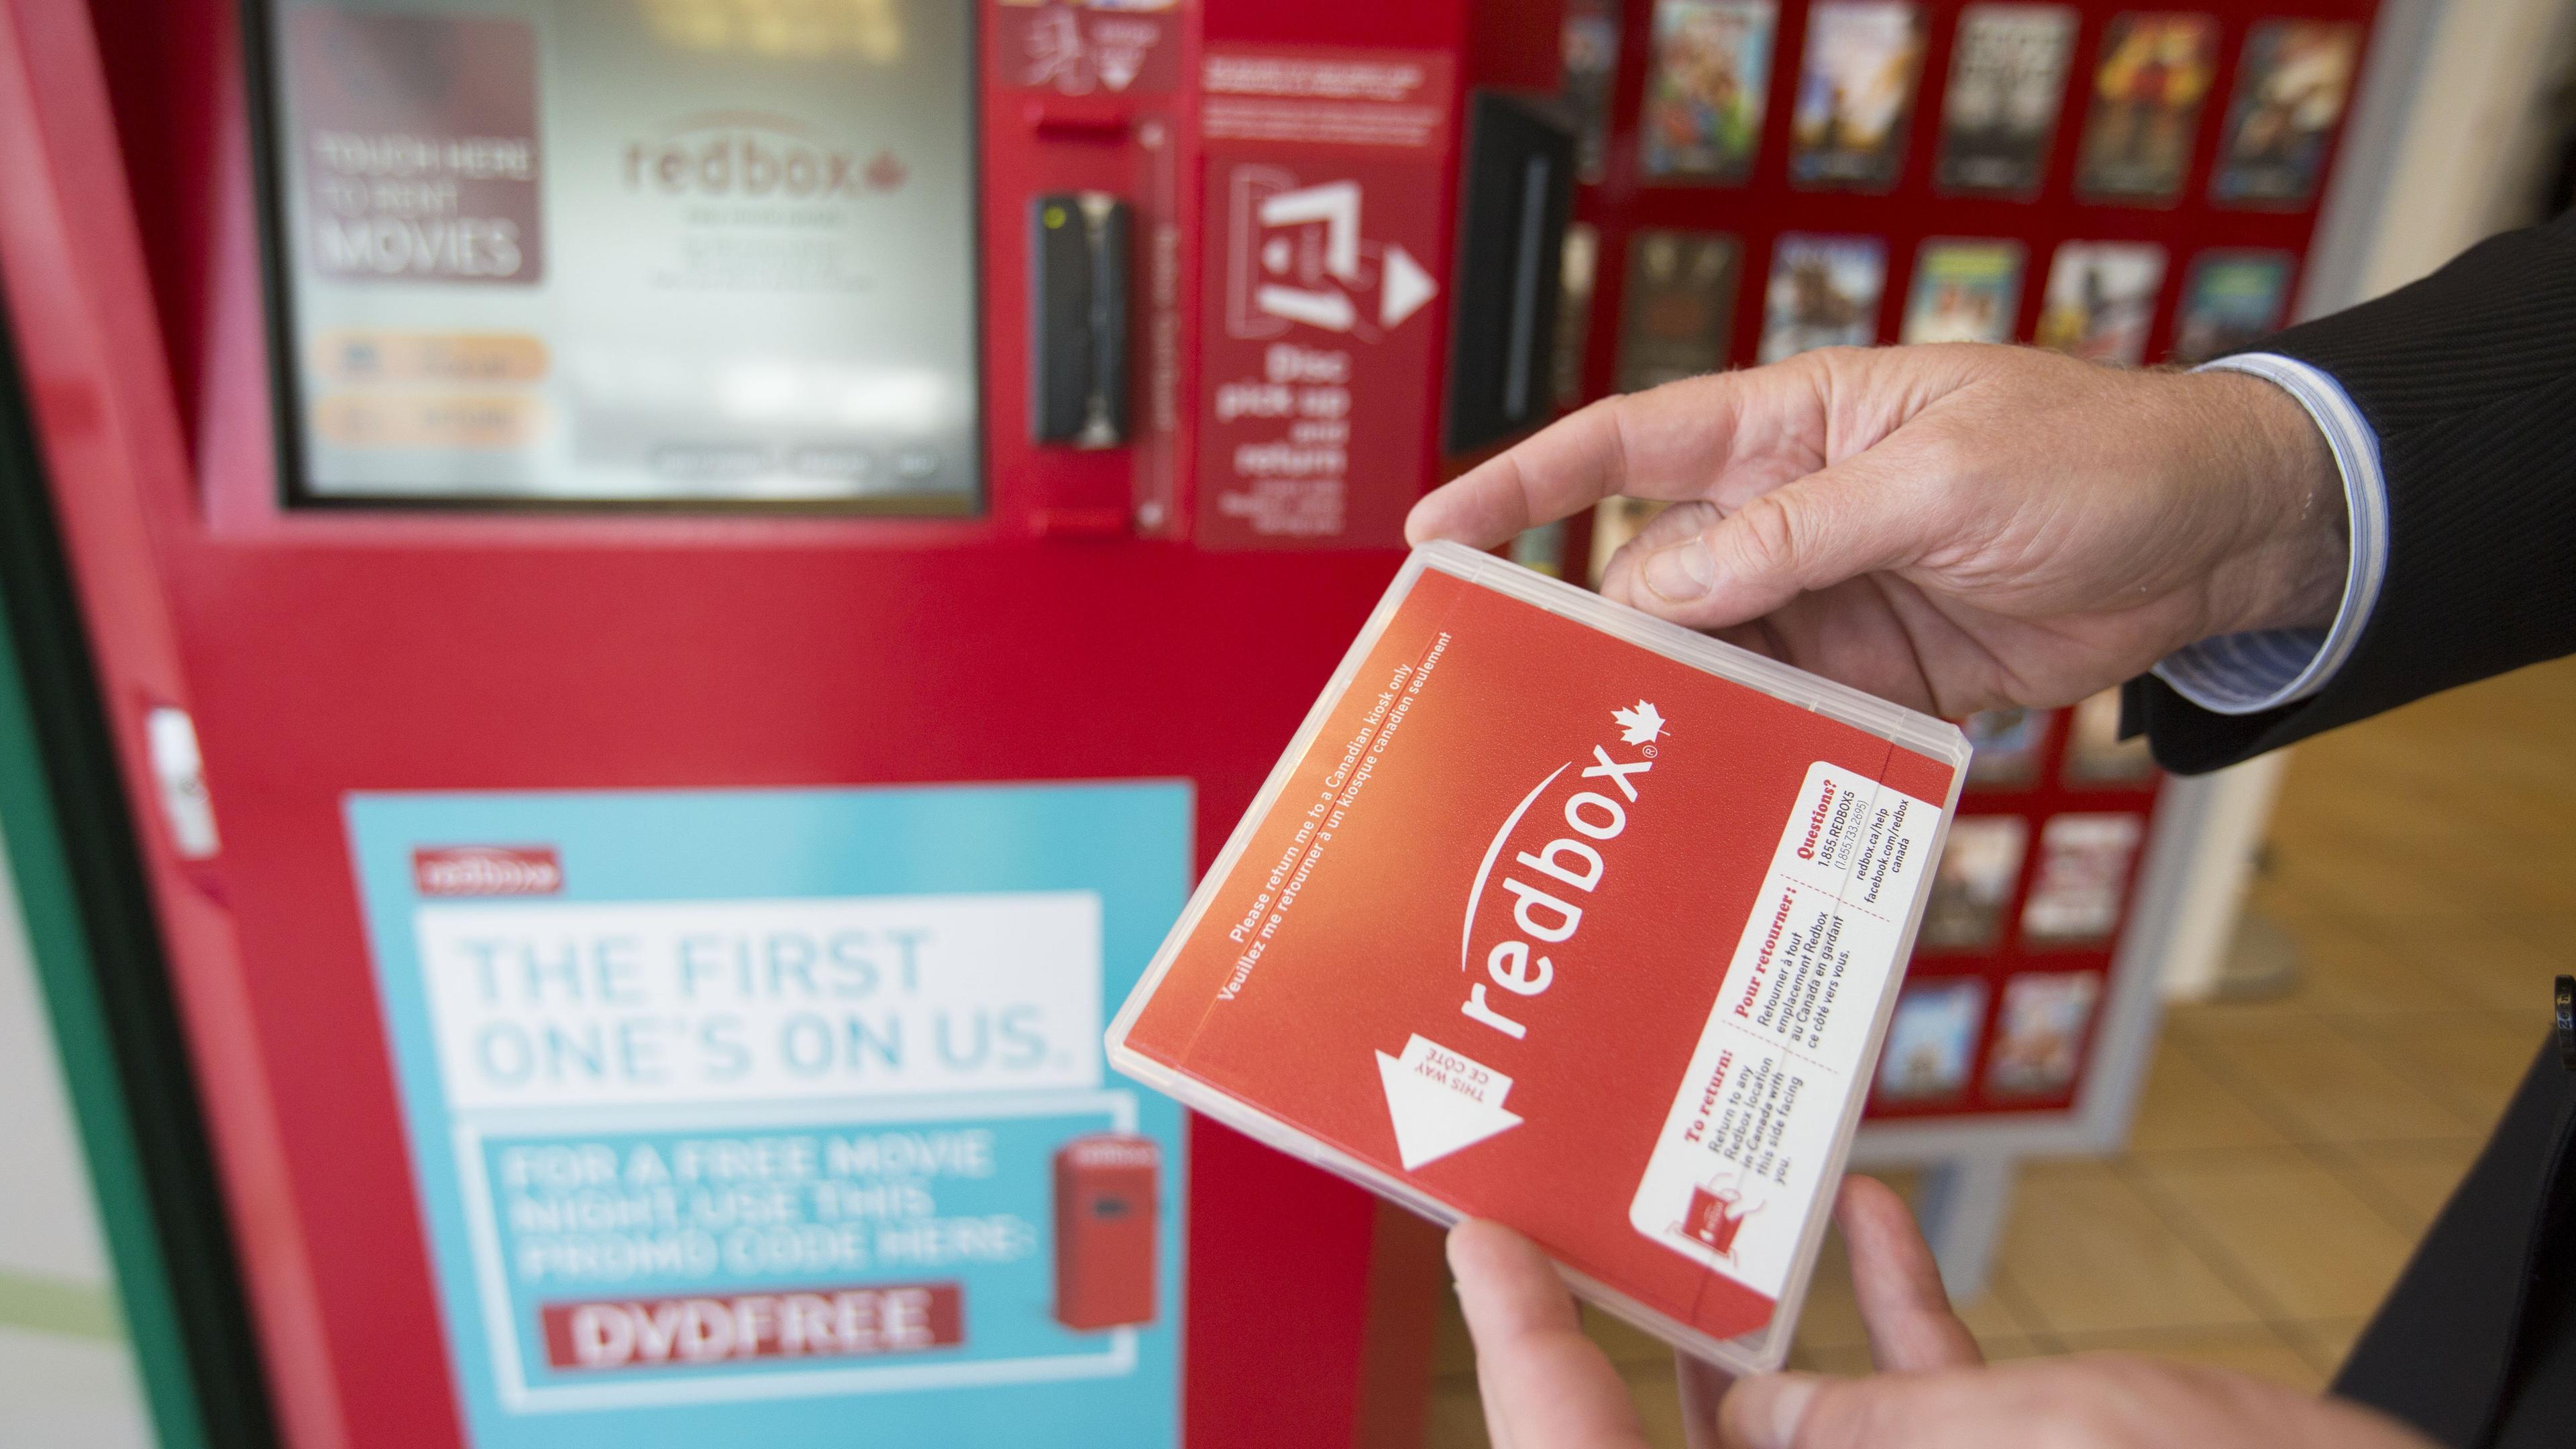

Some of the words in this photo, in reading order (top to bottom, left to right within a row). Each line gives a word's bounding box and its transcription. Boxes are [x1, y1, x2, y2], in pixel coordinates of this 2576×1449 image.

[623, 136, 861, 196] redbox
[318, 218, 522, 276] MOVIES
[1389, 663, 1413, 690] only
[1362, 692, 1395, 724] kiosk
[1324, 727, 1371, 788] Canadian
[1218, 941, 1266, 999] Veuillez
[1260, 914, 1281, 938] me
[1277, 842, 1324, 911] retourner
[1316, 831, 1332, 841] à
[1327, 810, 1344, 828] un
[1336, 755, 1377, 807] kiosque
[1373, 696, 1413, 753] canadien
[1408, 631, 1451, 694] seulement
[1307, 803, 1324, 818] to
[1321, 791, 1332, 803] a
[1796, 779, 1836, 860] Questions?
[1294, 820, 1314, 843] me
[1817, 790, 1854, 867] 1.855.REDBOX5
[1833, 800, 1869, 870] (1.855.733.2695)
[1856, 808, 1889, 880] redbox.ca/help
[1864, 799, 1909, 903] facebook.com/redbox
[1265, 846, 1299, 891] return
[1891, 838, 1909, 873] canada
[1229, 893, 1270, 943] Please
[1821, 915, 1843, 961] gardant
[460, 936, 644, 1003] THE
[679, 928, 931, 998] FIRST
[1781, 958, 1792, 967] à
[1784, 932, 1802, 956] tout
[1832, 950, 1849, 977] vous.
[1777, 955, 1811, 1033] emplacement
[1803, 911, 1828, 953] Redbox
[1815, 962, 1827, 977] en
[1824, 980, 1838, 1003] vers
[1735, 976, 1760, 1018] Pour
[1757, 968, 1788, 1026] Retourner
[1796, 979, 1820, 1022] Canada
[1813, 1006, 1829, 1031] côté
[782, 1009, 904, 1077] ON
[938, 1004, 1071, 1071] US.
[1791, 1026, 1803, 1041] au
[1808, 1034, 1819, 1048] ce
[1415, 1062, 1446, 1083] WAY
[1451, 1078, 1483, 1102] THIS
[1469, 1069, 1489, 1084] CE
[1684, 1120, 1704, 1142] To
[1700, 1049, 1733, 1115] return:
[1708, 1109, 1734, 1152] Return
[1729, 1092, 1741, 1104] to
[1738, 1065, 1754, 1088] any
[1724, 1113, 1751, 1159] Redbox
[1746, 1057, 1772, 1108] location
[1741, 1155, 1752, 1168] in
[1748, 1102, 1772, 1150] Canada
[1769, 1072, 1784, 1098] with
[1756, 1151, 1773, 1175] this
[1769, 1120, 1784, 1146] side
[1777, 1076, 1803, 1116] facing
[502, 1144, 617, 1187] FOR
[624, 1144, 671, 1184] A
[674, 1136, 816, 1180] FREE
[827, 1130, 995, 1179] MOVIE
[691, 1183, 798, 1228] USE
[815, 1179, 934, 1220] THIS
[521, 1232, 718, 1282] PROMO
[724, 1223, 867, 1274] CODE
[570, 1287, 935, 1366] DVDFREE
